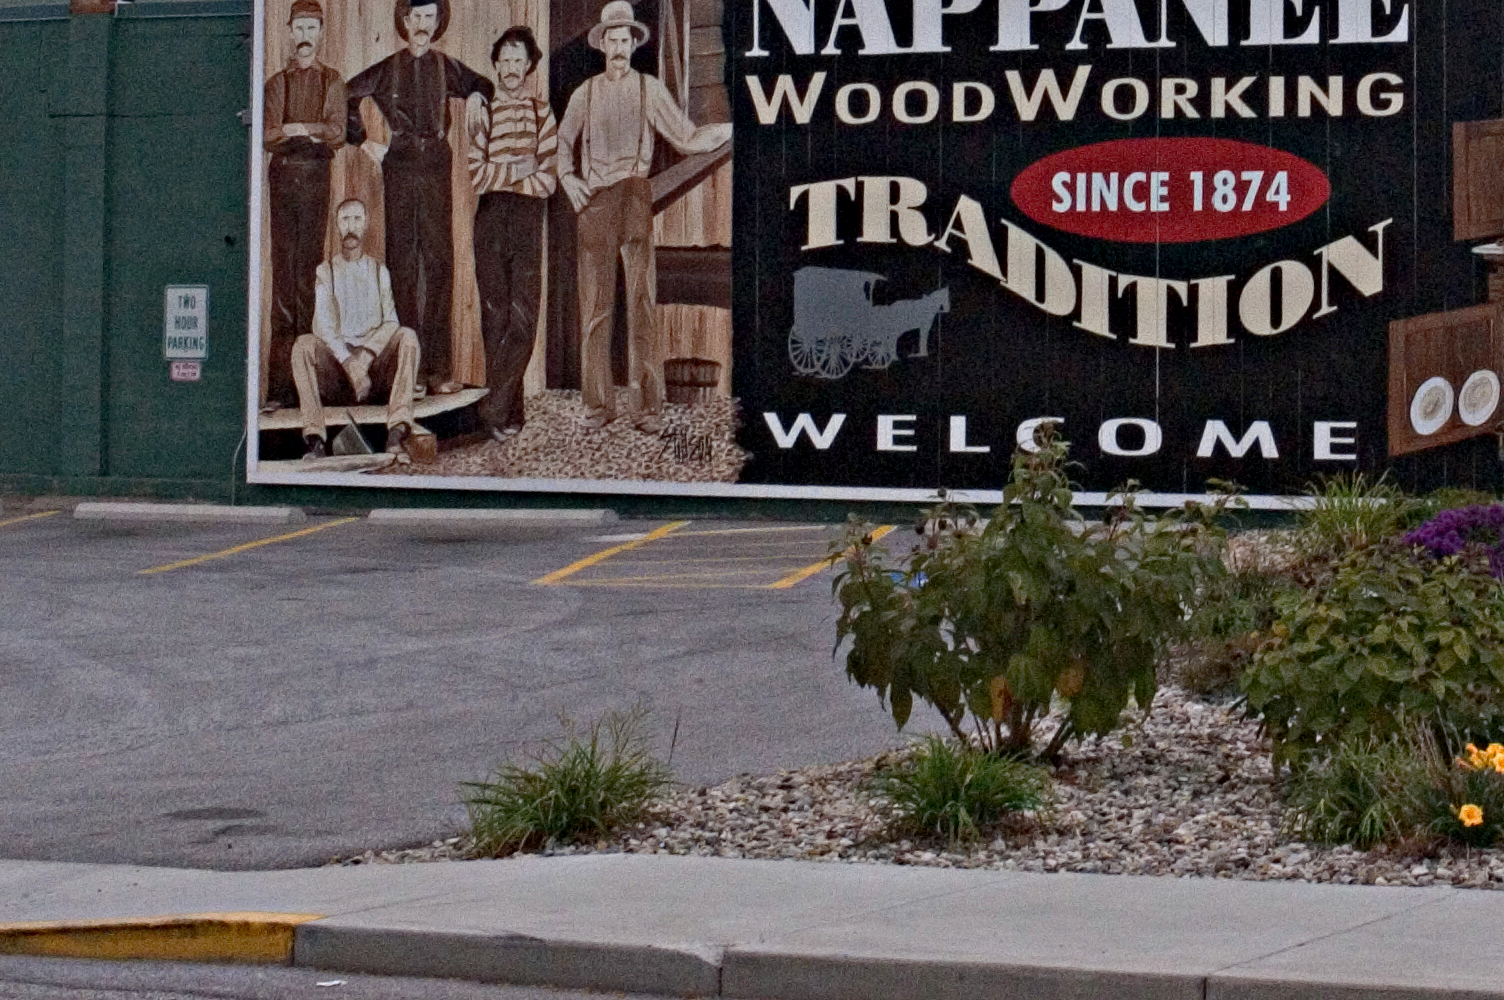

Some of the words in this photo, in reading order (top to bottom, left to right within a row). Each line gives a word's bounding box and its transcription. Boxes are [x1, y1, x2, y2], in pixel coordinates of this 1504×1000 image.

[1051, 171, 1170, 213] SINCE
[1189, 170, 1291, 212] 1874
[789, 175, 1394, 349] TRADITION
[177, 294, 196, 310] TWO
[174, 315, 199, 330] HOUR
[167, 336, 206, 351] PARKING
[763, 411, 1358, 461] WELCOME
